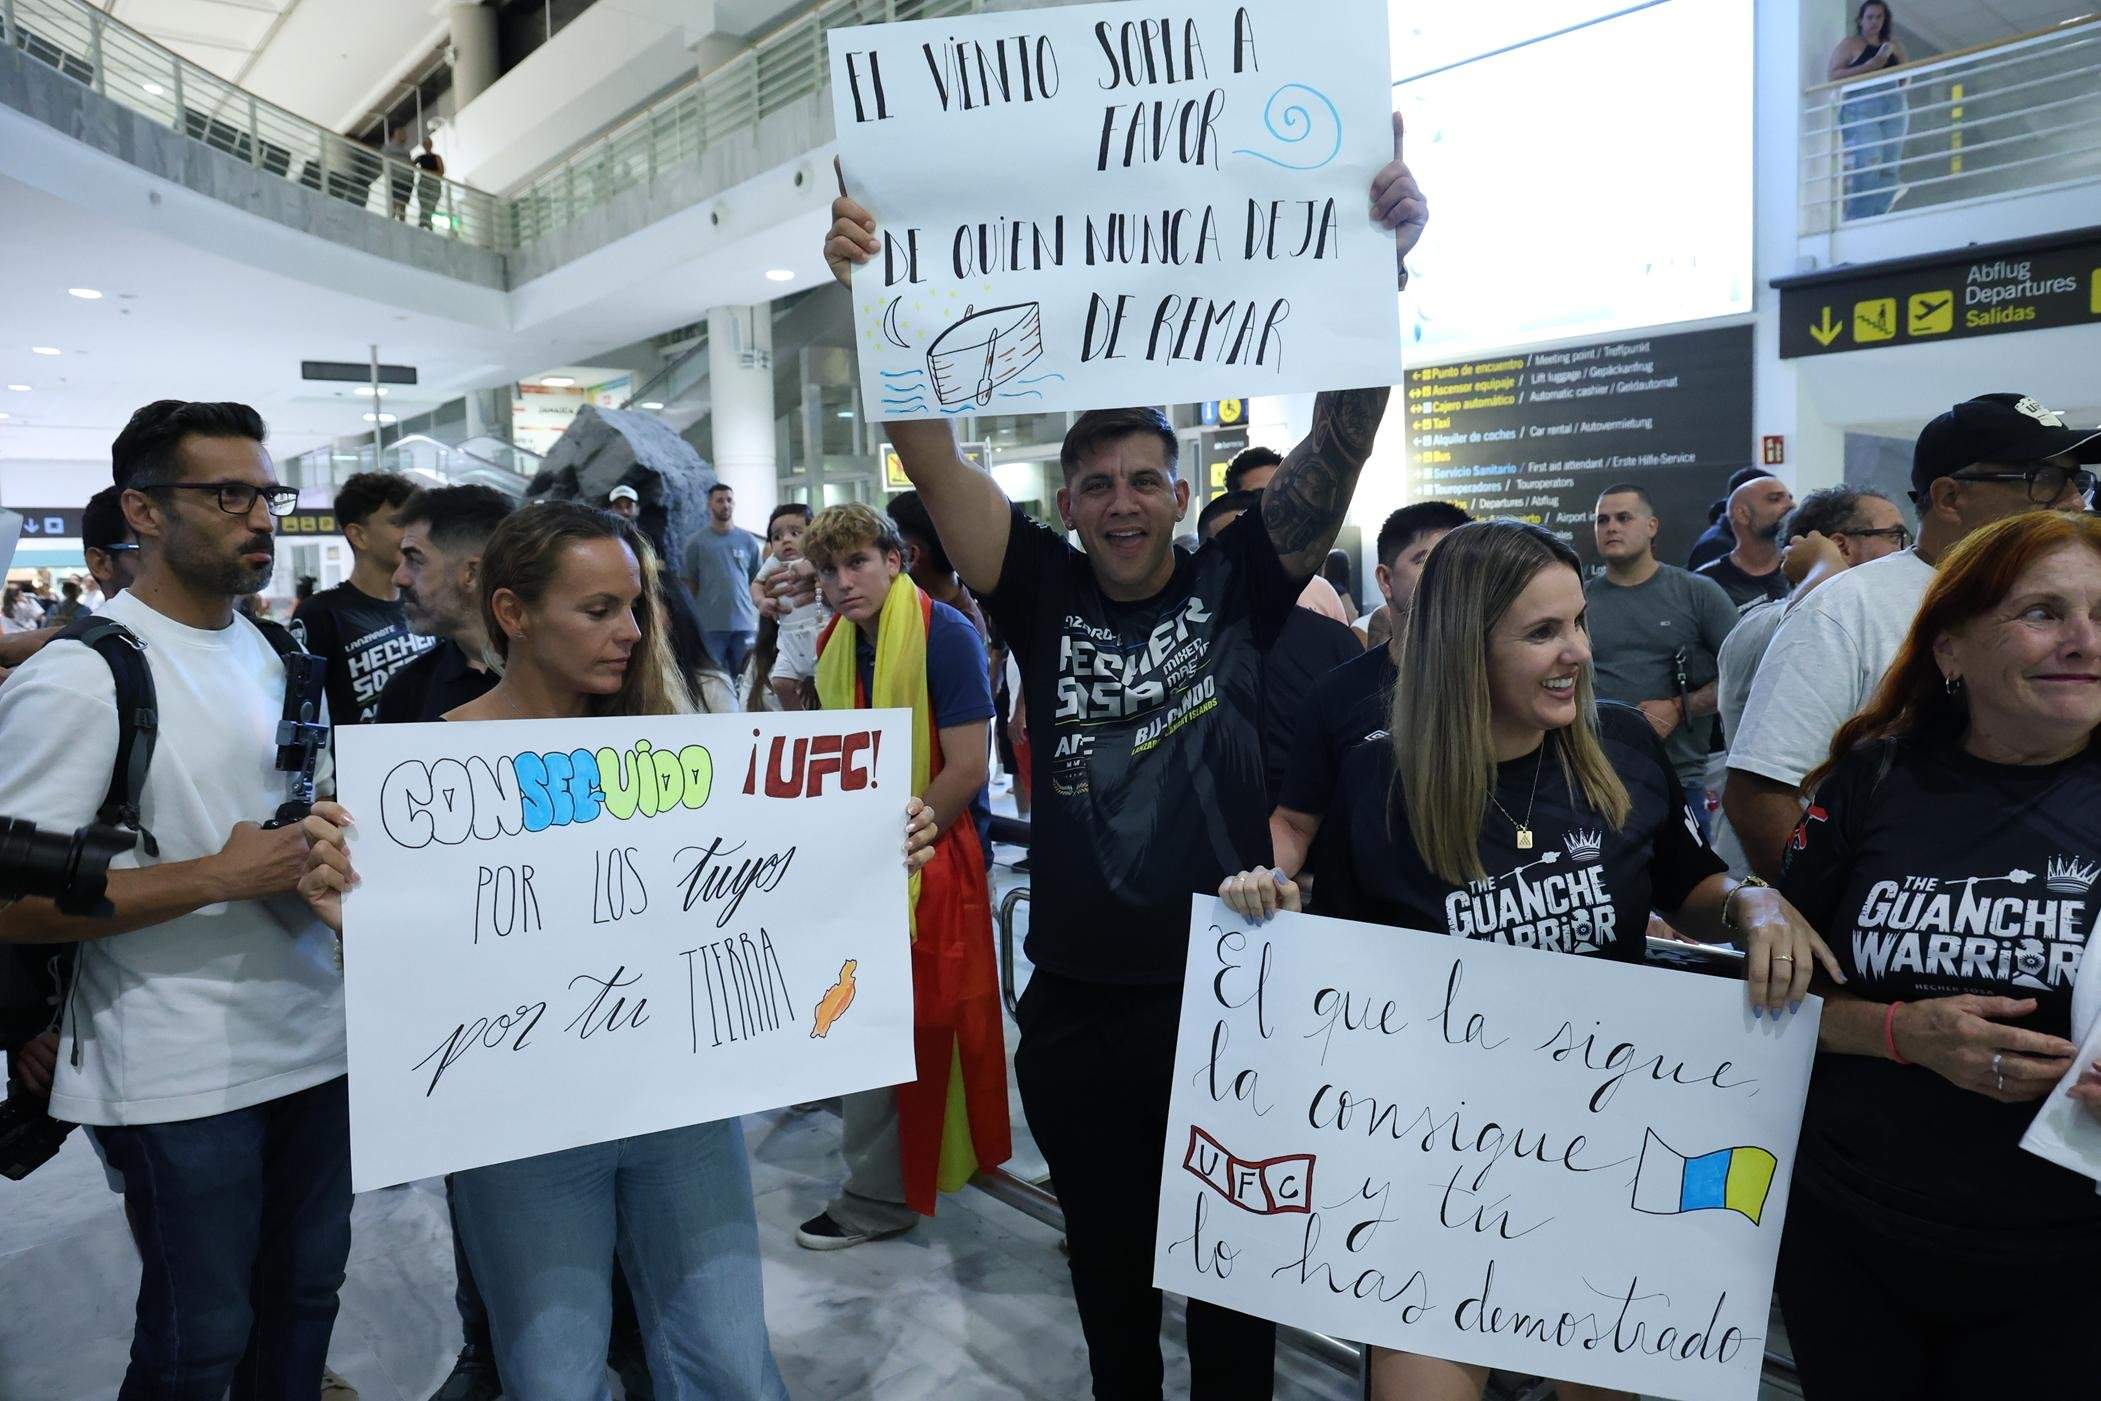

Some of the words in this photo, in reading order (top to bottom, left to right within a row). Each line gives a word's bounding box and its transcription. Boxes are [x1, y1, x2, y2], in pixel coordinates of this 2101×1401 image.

[846, 50, 894, 123] EL
[1094, 17, 1208, 91] SOPLA
[1233, 7, 1258, 74] A
[1097, 88, 1225, 172] FAVOR
[884, 228, 927, 287] DE
[1085, 204, 1220, 266] NUNCA
[1245, 197, 1340, 262] DEJA
[1966, 275, 2078, 306] Departures
[1967, 261, 2032, 284] Abflug
[1080, 292, 1136, 362] DE
[1146, 293, 1290, 374] REMAR
[1966, 305, 2035, 328] Salidas
[1432, 366, 1459, 380] Punto
[1461, 364, 1473, 377] de
[1475, 359, 1524, 373] encuentro
[1535, 351, 1570, 366] Meeting
[1573, 347, 1595, 362] point
[1433, 383, 1473, 397] Ascensor
[1474, 376, 1515, 393] equipaje
[1548, 369, 1582, 384] luggage
[1433, 401, 1461, 414] Cajero
[1530, 387, 1574, 402] Automatic
[1576, 384, 1609, 397] cashier
[1616, 376, 1678, 394] Geldautomat
[1433, 432, 1467, 446] Alquiler
[1469, 430, 1481, 443] de
[1529, 425, 1546, 437] Car
[1547, 423, 1573, 436] rental
[1580, 416, 1653, 433] Autovermietung
[1434, 466, 1472, 480] Servicio
[1472, 463, 1517, 477] Sanitario
[1527, 461, 1548, 473] First
[1549, 460, 1563, 472] aid
[1564, 458, 1604, 471] attendant
[1612, 456, 1637, 468] Erste
[1517, 477, 1574, 490] Touroperators
[1479, 498, 1524, 510] Departures
[1531, 495, 1560, 508] Abflug
[1556, 512, 1587, 524] Airport
[741, 728, 883, 799] ¡UFC!
[474, 864, 542, 945] POR
[593, 847, 648, 924] LOS
[673, 836, 797, 928] tuyos
[1445, 864, 1612, 939] GUANCHE
[1468, 876, 1497, 895] THE
[1903, 875, 1939, 892] THE
[1857, 877, 2087, 942] GUANCHE
[411, 1001, 547, 1098] por
[563, 965, 650, 1040] tu
[679, 927, 795, 1054] TIERRA
[1209, 924, 1274, 1039] El
[1303, 985, 1408, 1066] que
[1427, 958, 1510, 1051] la
[1192, 1019, 1275, 1117] la
[1321, 1176, 1400, 1252] y
[1428, 1165, 1556, 1240] tú
[1168, 1192, 1243, 1279] lo
[1271, 1212, 1437, 1325] has
[1453, 1260, 1763, 1365] demostrado
